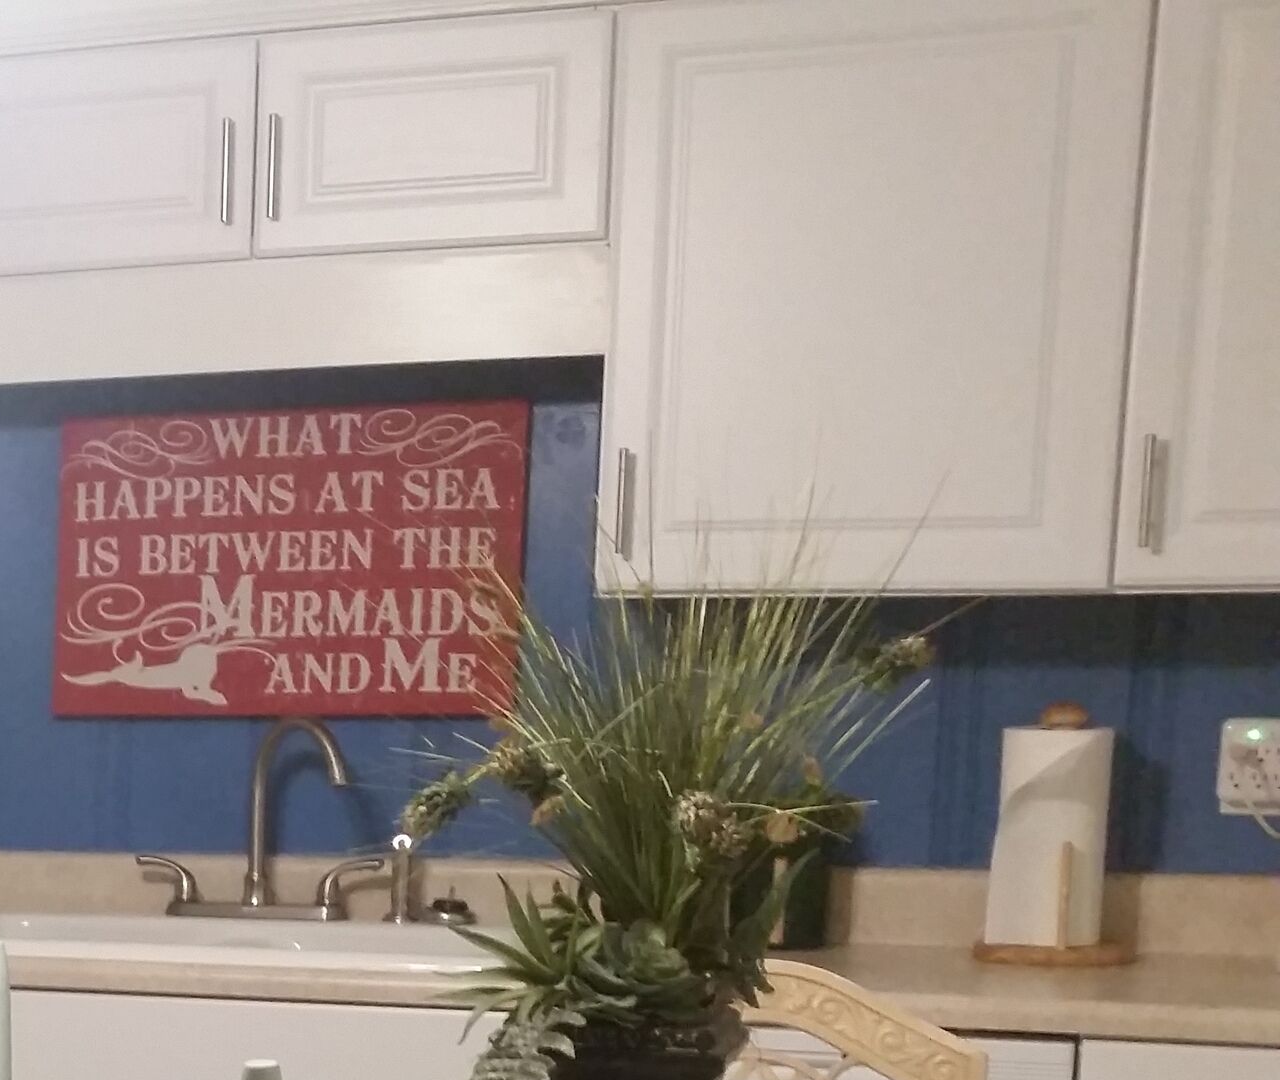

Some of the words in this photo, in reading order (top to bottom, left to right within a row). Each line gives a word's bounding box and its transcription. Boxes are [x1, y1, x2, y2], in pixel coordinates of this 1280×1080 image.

[208, 414, 362, 459] WHAT
[75, 473, 296, 522] HAPPENS
[314, 470, 384, 513] AT
[401, 467, 501, 511] SEA
[76, 537, 120, 577] IS
[139, 529, 374, 576] BETWEEN
[394, 527, 497, 569] THE
[199, 574, 500, 638] MERMAIDS
[264, 652, 372, 695] AND
[383, 637, 478, 693] ME
